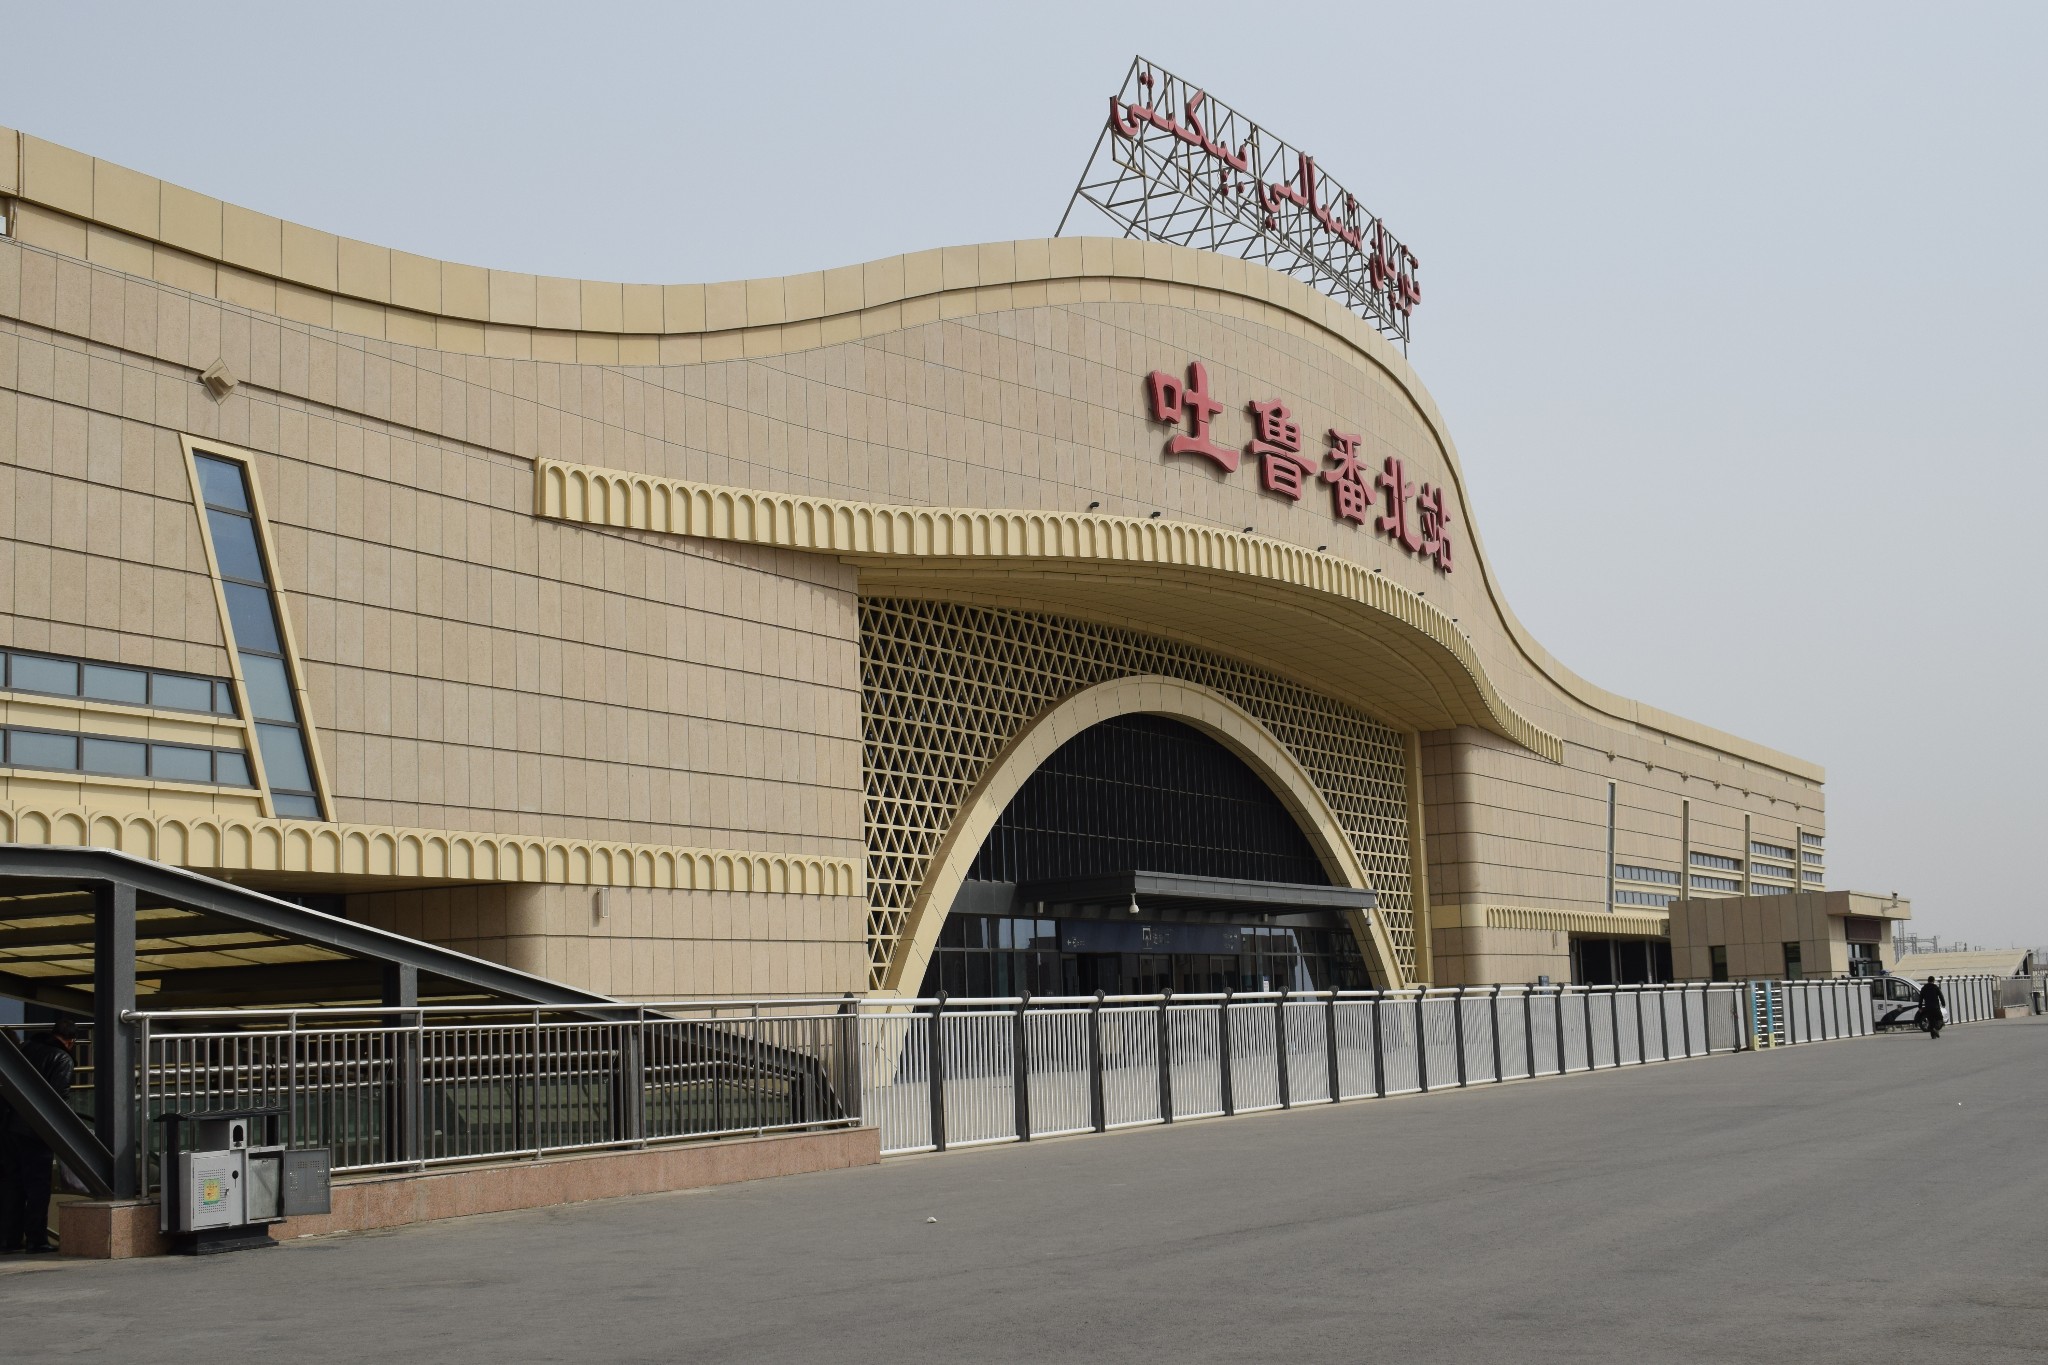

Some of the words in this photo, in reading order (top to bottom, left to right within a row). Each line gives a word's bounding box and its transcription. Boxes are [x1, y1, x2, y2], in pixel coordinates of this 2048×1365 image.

[1150, 360, 1453, 574] 吐鲁番北站
